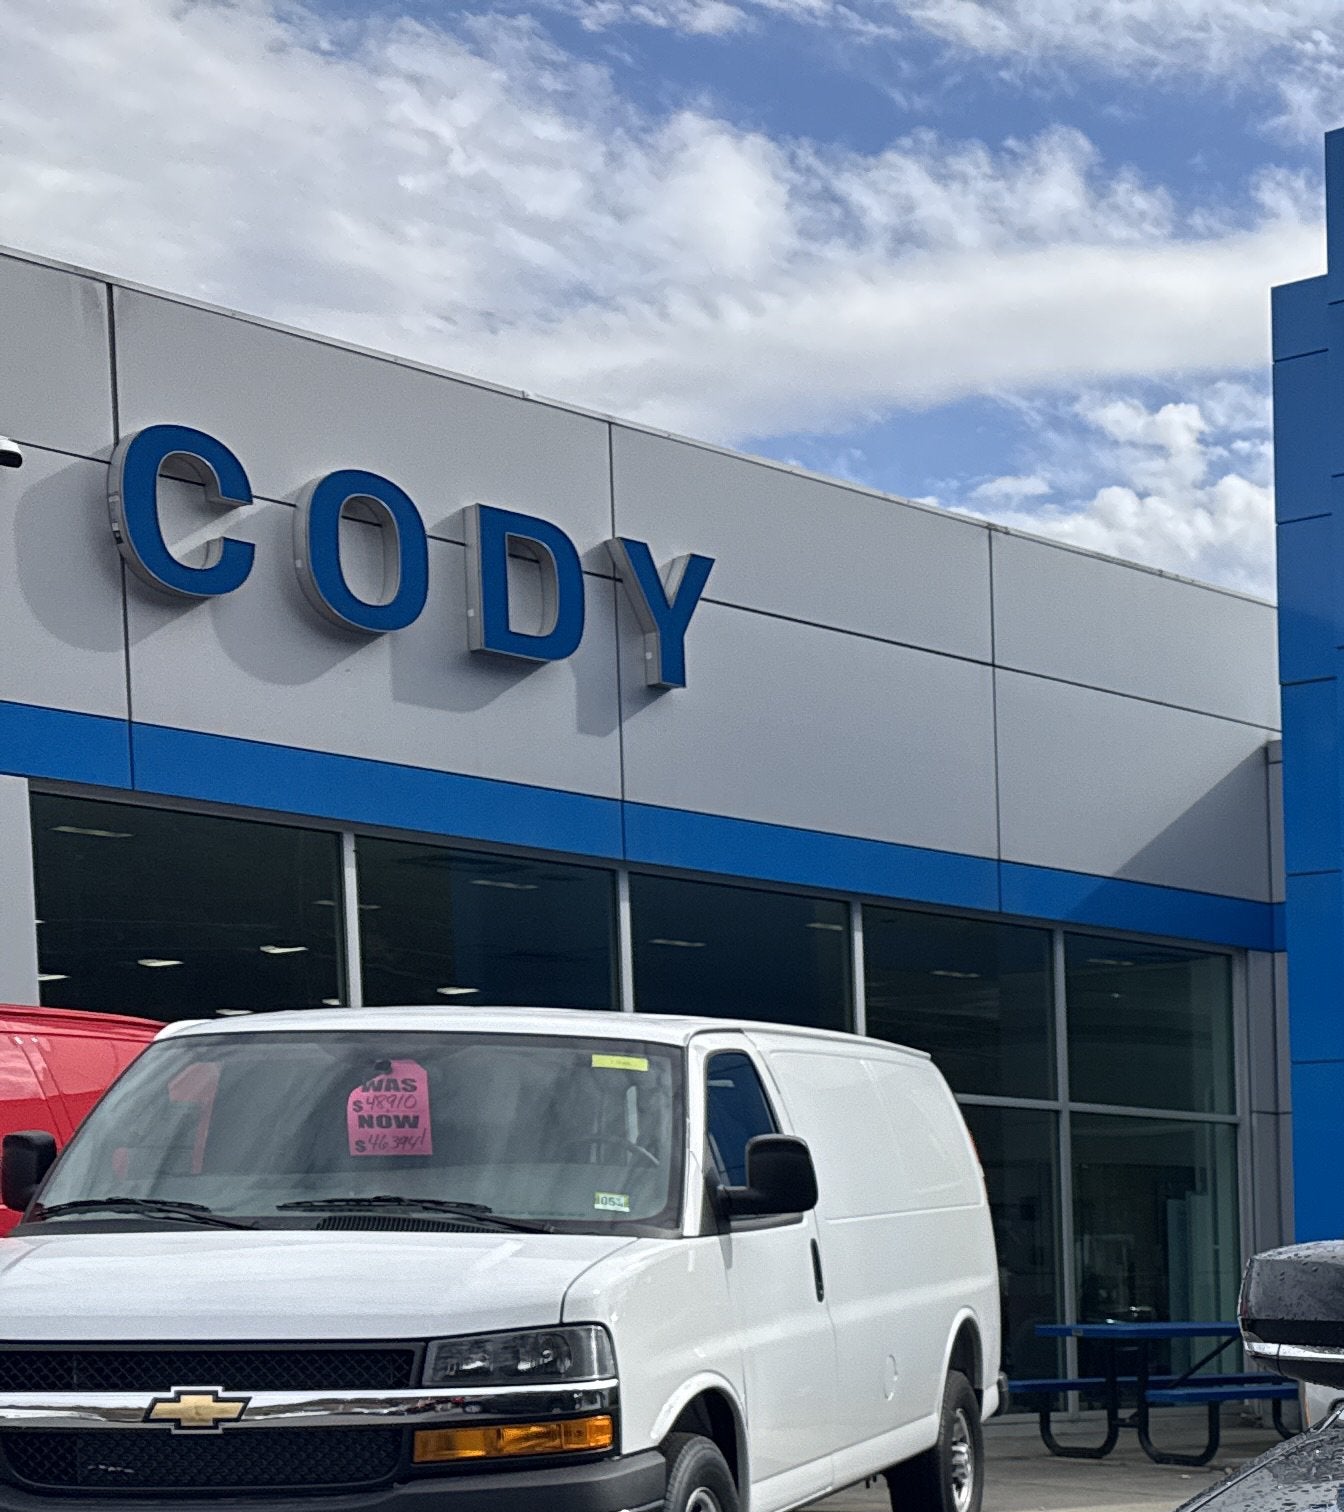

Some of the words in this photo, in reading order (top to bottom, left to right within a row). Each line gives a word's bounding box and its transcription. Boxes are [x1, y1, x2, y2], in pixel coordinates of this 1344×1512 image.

[109, 424, 715, 689] CODY
[360, 1078, 418, 1092] WAS
[358, 1114, 420, 1129] NOW
